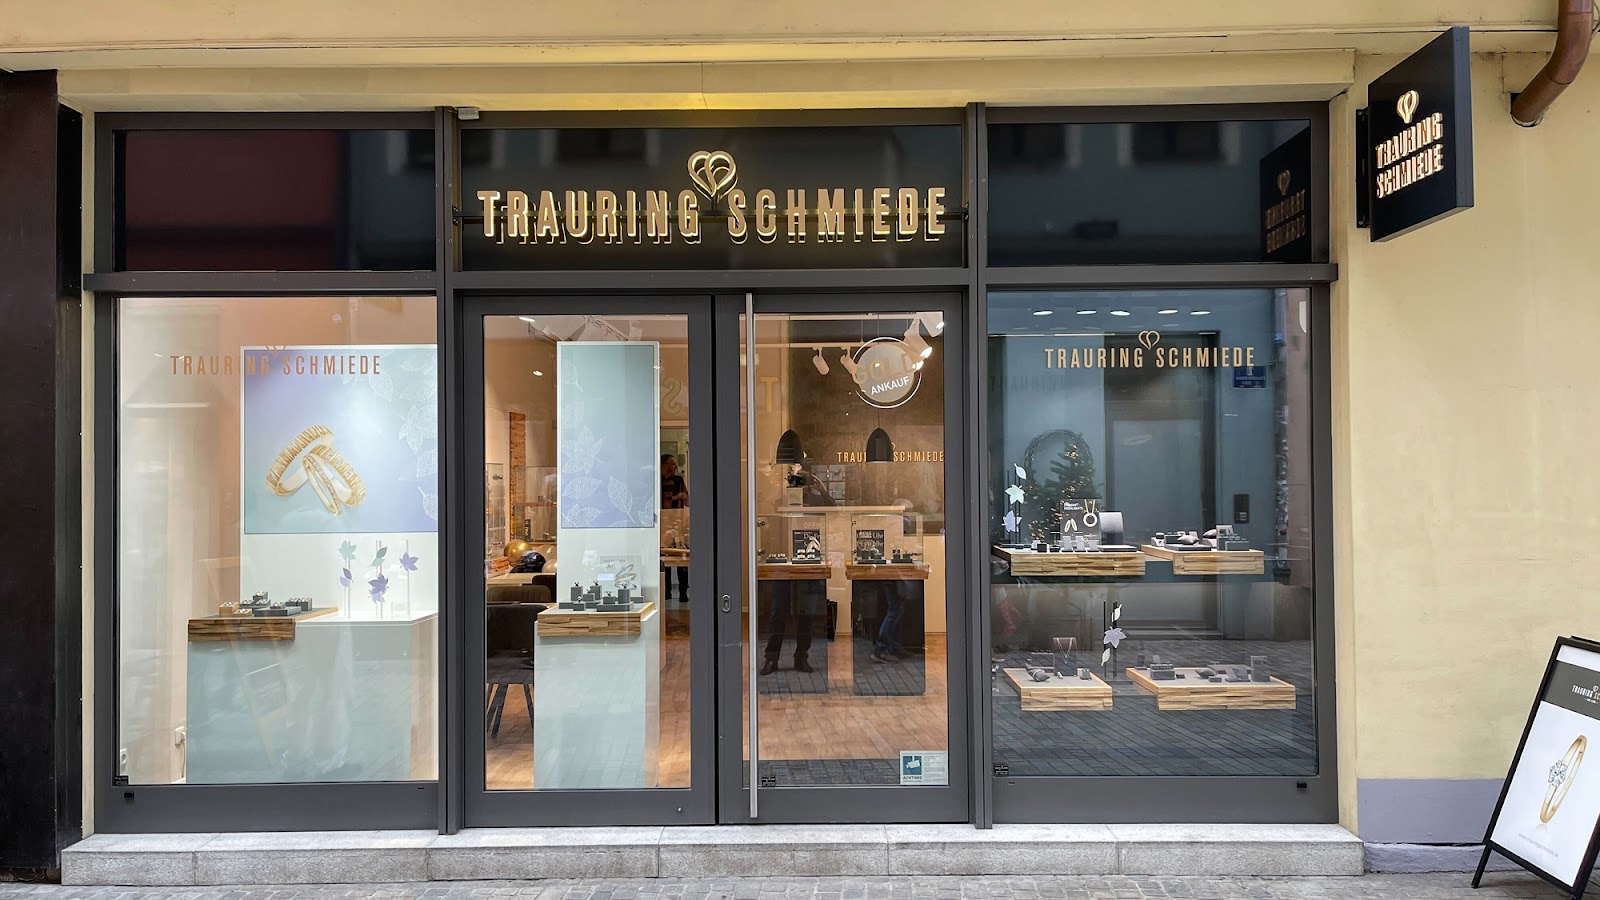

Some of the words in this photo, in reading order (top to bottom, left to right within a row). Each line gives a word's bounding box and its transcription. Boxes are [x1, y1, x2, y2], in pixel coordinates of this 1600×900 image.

[1375, 112, 1443, 169] TRAURING
[1376, 143, 1444, 199] SCHMIEDE
[477, 190, 700, 239] TRAURING
[727, 187, 947, 238] SCHMIEDE
[282, 355, 382, 375] SCHMIEDE
[1044, 348, 1144, 369] TRAURING
[1155, 347, 1255, 368] SCHMIEDE
[871, 375, 910, 395] ANKAUF
[893, 450, 945, 463] SCHMIEDE
